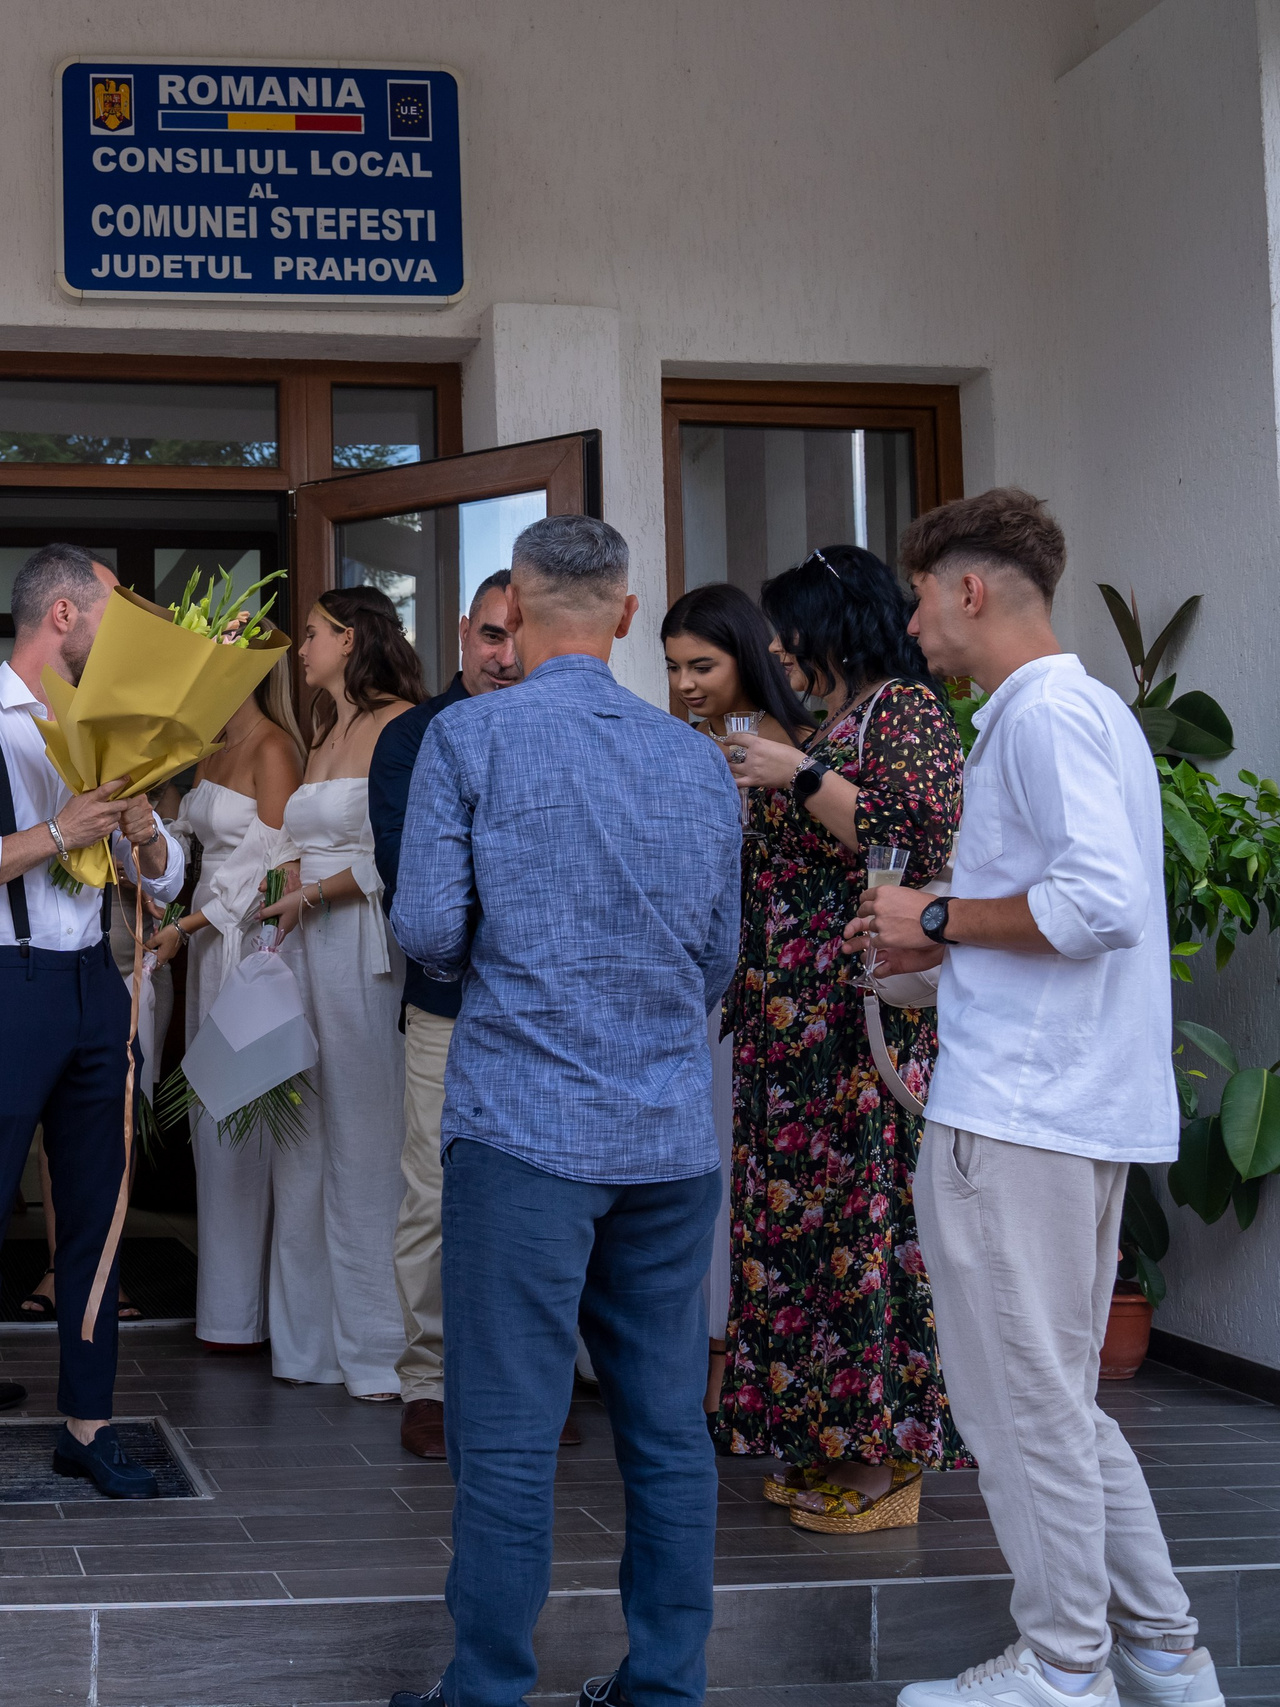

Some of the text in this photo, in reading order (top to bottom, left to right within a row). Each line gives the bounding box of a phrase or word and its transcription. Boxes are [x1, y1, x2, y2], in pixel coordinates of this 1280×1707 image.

[158, 74, 365, 108] ROMANIA
[400, 106, 420, 115] U.E.
[92, 147, 433, 178] CONSILIUL LOCAL
[249, 183, 279, 199] AL
[91, 204, 436, 242] COMUNEI STEFESTI
[91, 254, 437, 283] JUDETUL PRAHOVA
